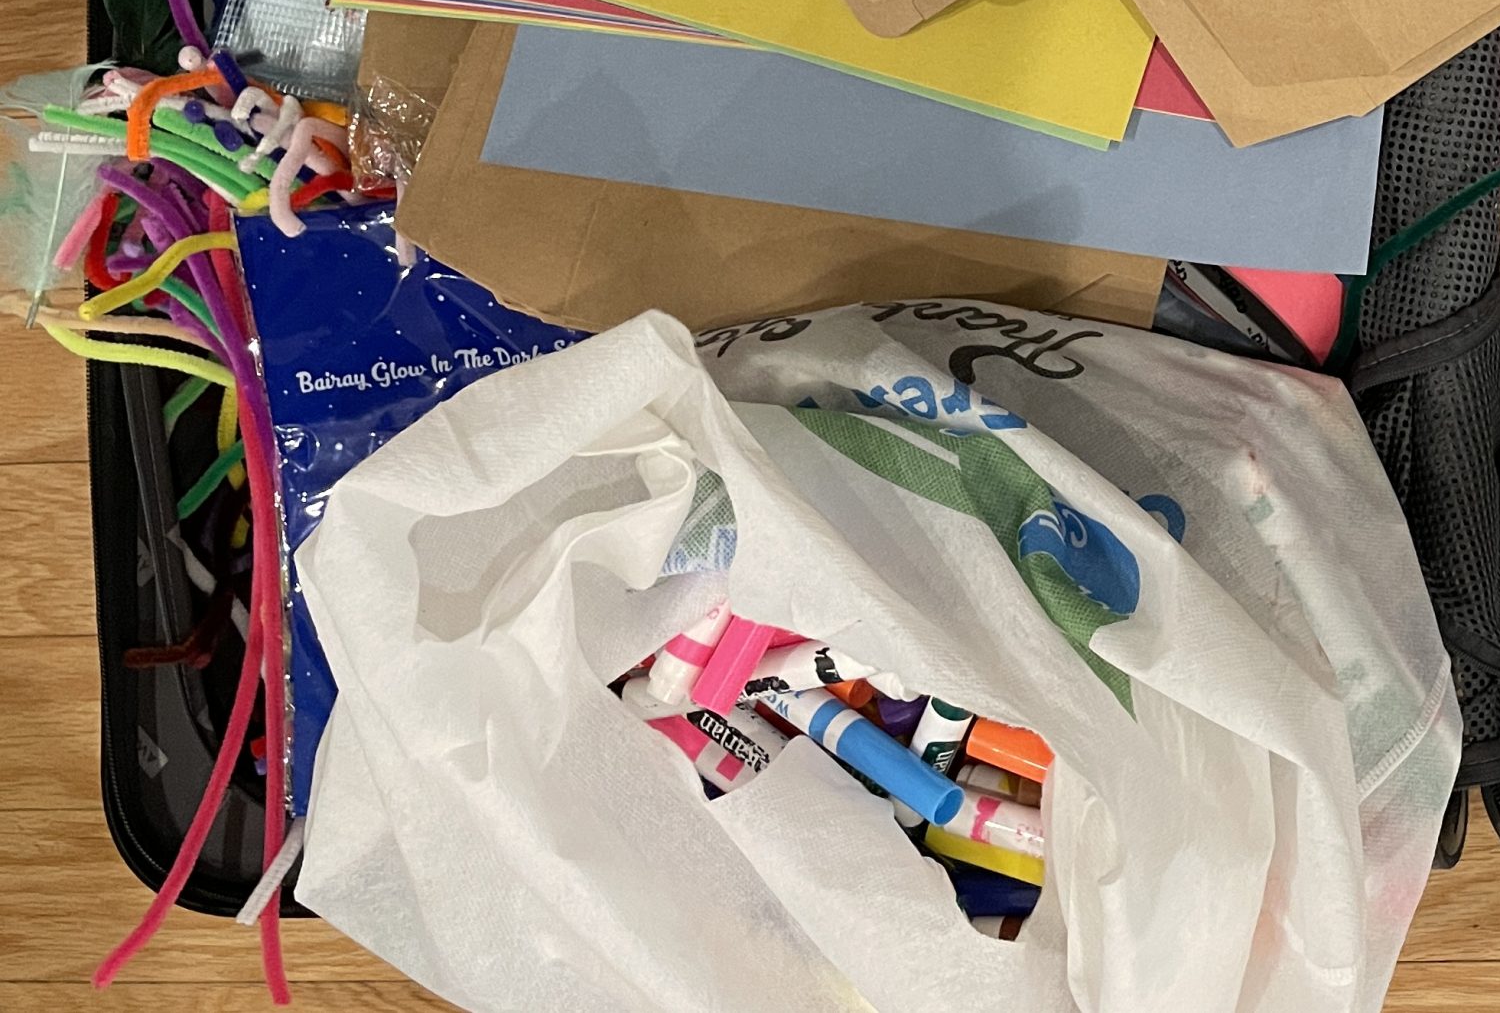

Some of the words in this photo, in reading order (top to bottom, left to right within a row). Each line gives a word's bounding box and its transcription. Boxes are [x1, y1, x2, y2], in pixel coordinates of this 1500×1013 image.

[296, 370, 371, 394] Bairay
[370, 362, 426, 387] Glow
[431, 354, 453, 374] In
[454, 348, 494, 369] The
